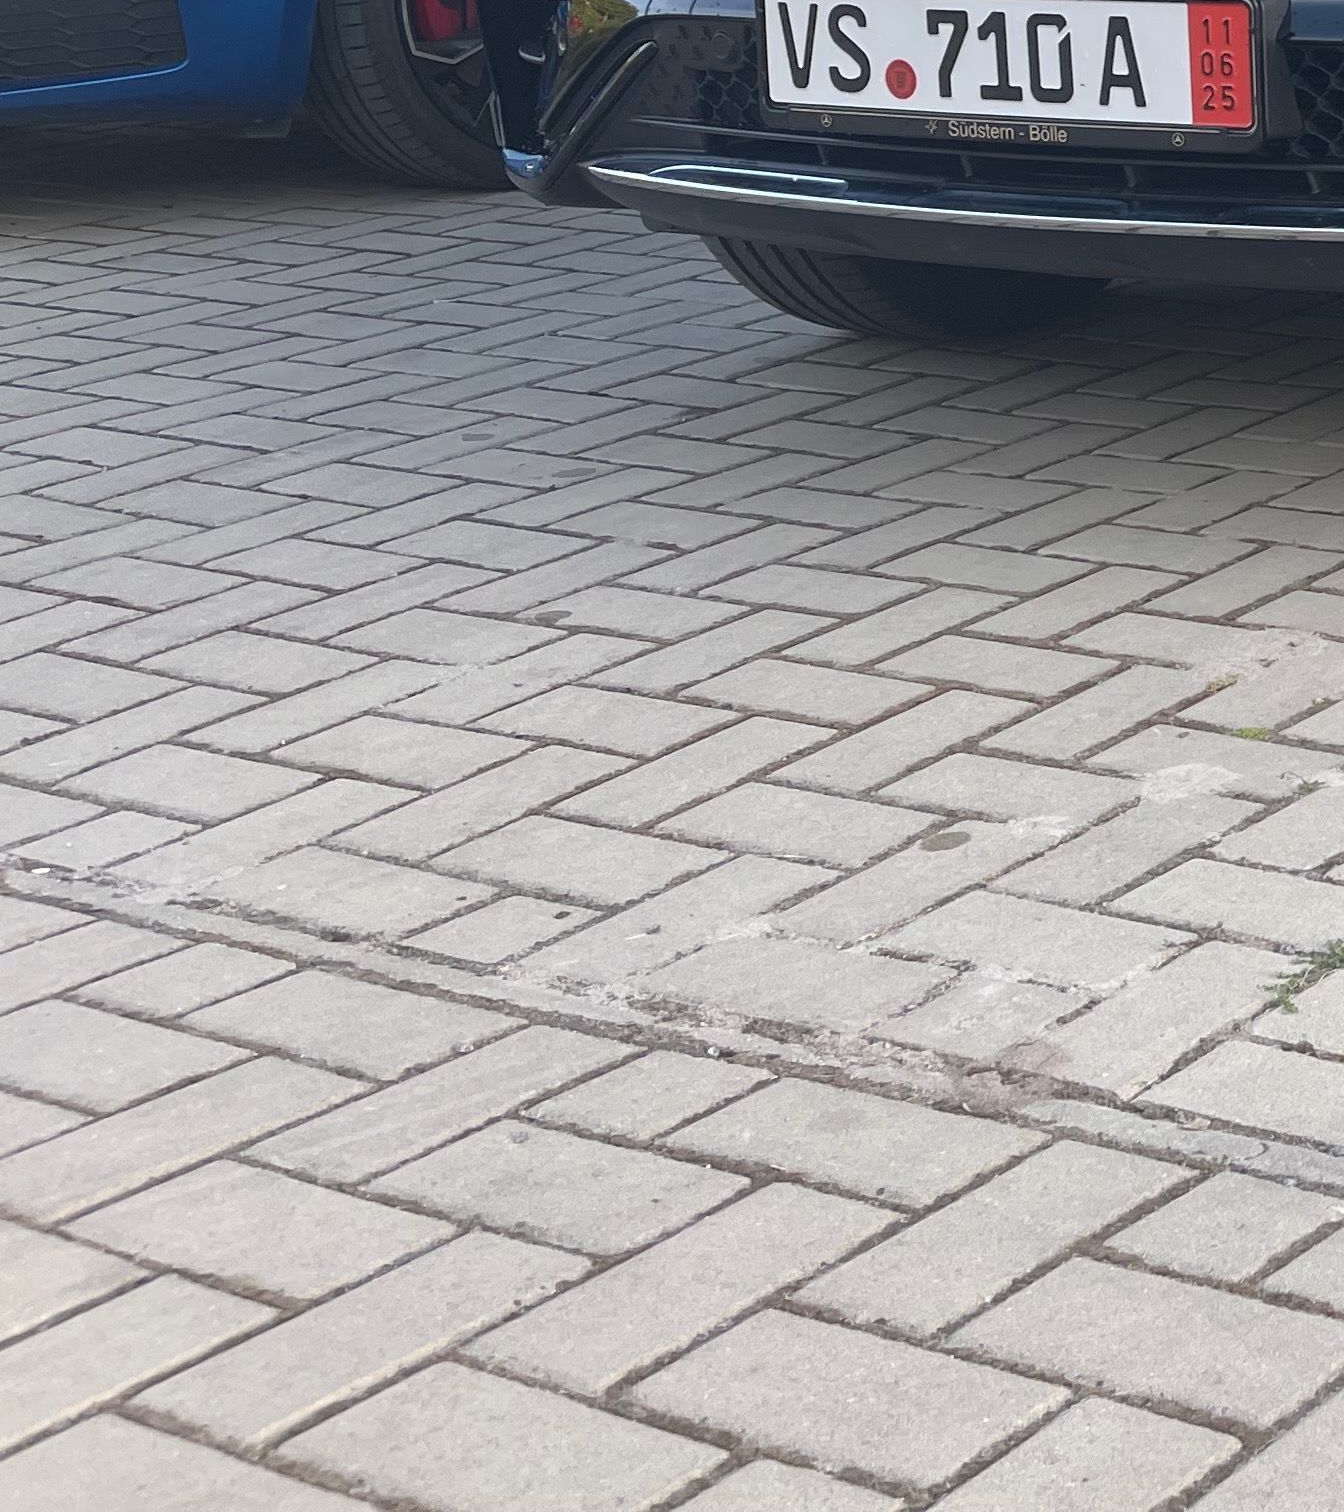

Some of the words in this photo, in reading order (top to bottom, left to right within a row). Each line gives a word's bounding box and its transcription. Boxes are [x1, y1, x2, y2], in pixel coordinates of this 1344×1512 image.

[1202, 17, 1230, 45] 11
[777, 1, 871, 93] VS
[926, 8, 1074, 104] 710
[1099, 15, 1147, 108] A
[1201, 51, 1234, 76] 06
[1203, 85, 1235, 111] 25
[948, 120, 1015, 140] Südstern
[1029, 124, 1068, 143] Bölle
